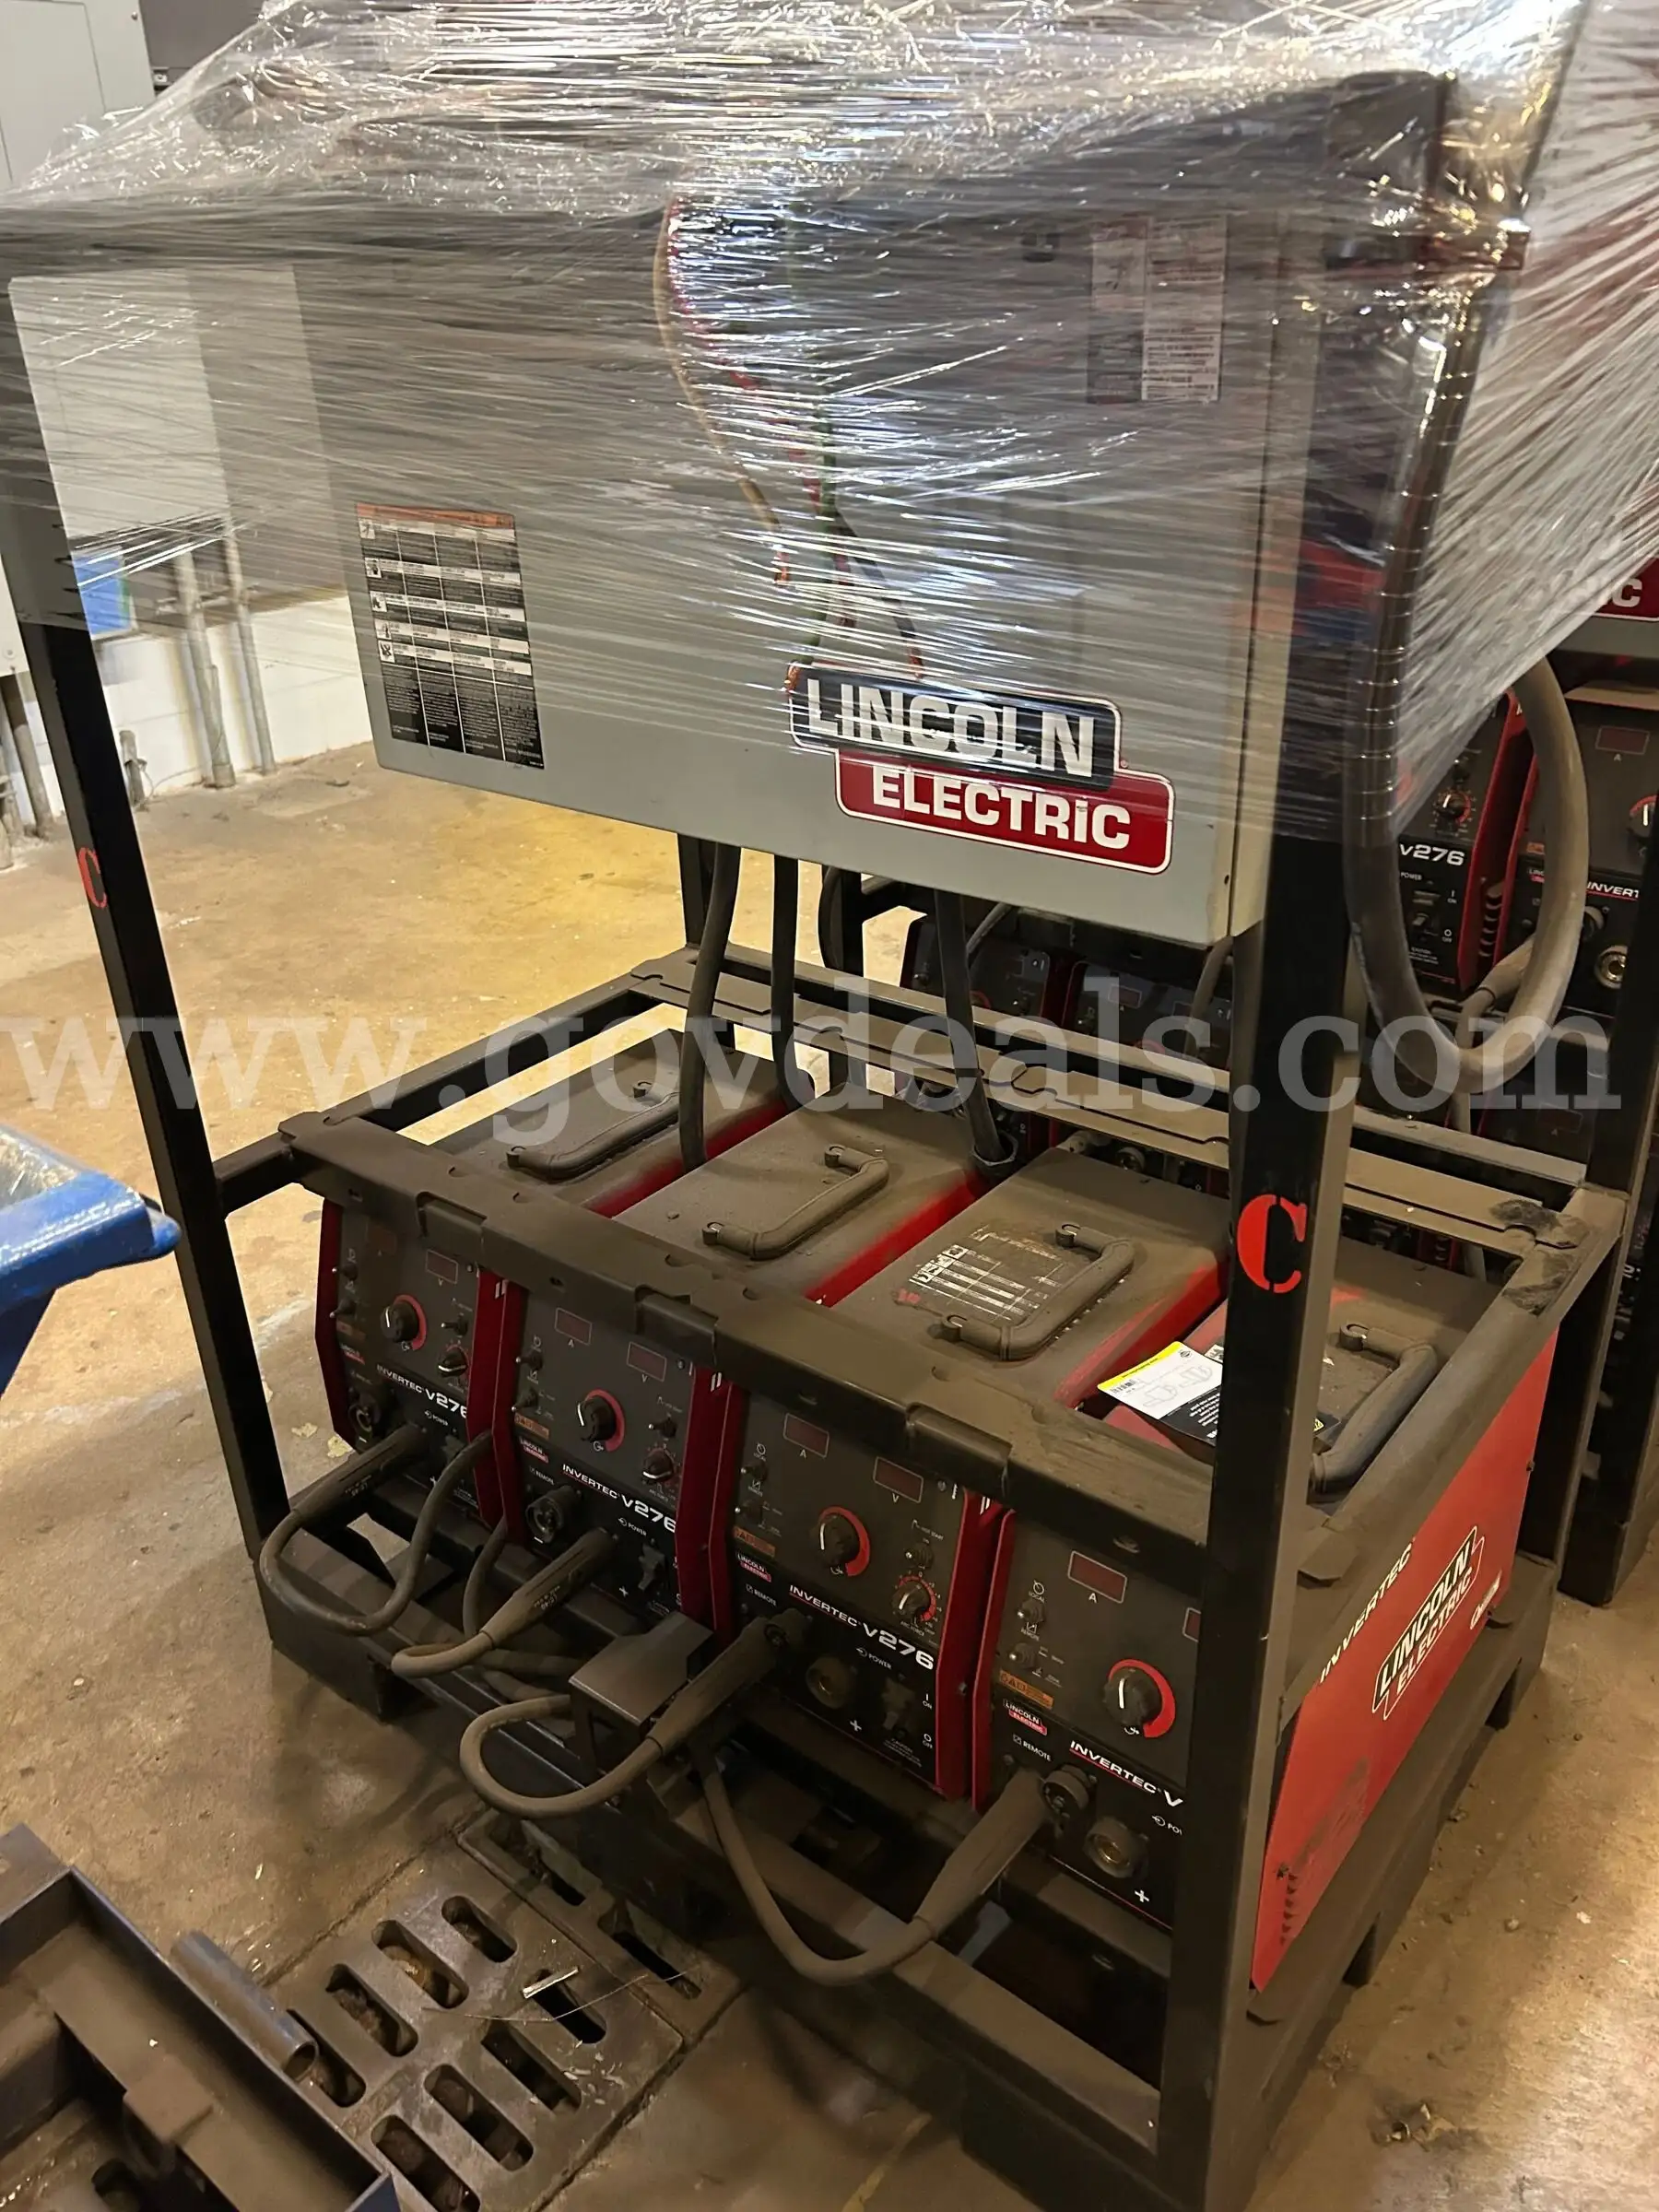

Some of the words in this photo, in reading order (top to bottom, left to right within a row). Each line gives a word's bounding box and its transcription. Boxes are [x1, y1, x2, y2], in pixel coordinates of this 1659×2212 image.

[807, 678, 1095, 778] LINCOLN
[1399, 843, 1465, 865] V276
[1237, 1194, 1308, 1293] C
[376, 1363, 423, 1393] INVERTEC
[563, 1464, 618, 1500] INVERTEC
[620, 1494, 677, 1533] V276
[737, 1553, 765, 1572] LINCOLN
[754, 1588, 777, 1606] REMOTE
[1088, 1593, 1098, 1604] A
[1320, 1543, 1412, 1684] INVERTEC
[789, 1584, 858, 1628] INVERTEC
[863, 1622, 935, 1670] V276
[1380, 1541, 1470, 1697] LINCOLN
[1397, 1567, 1472, 1695] ELECTRIC
[868, 1652, 892, 1670] POWER
[1006, 1701, 1040, 1724] LINCOLN
[1023, 1740, 1052, 1761] REMOTE
[1070, 1740, 1157, 1794] INVERTEC
